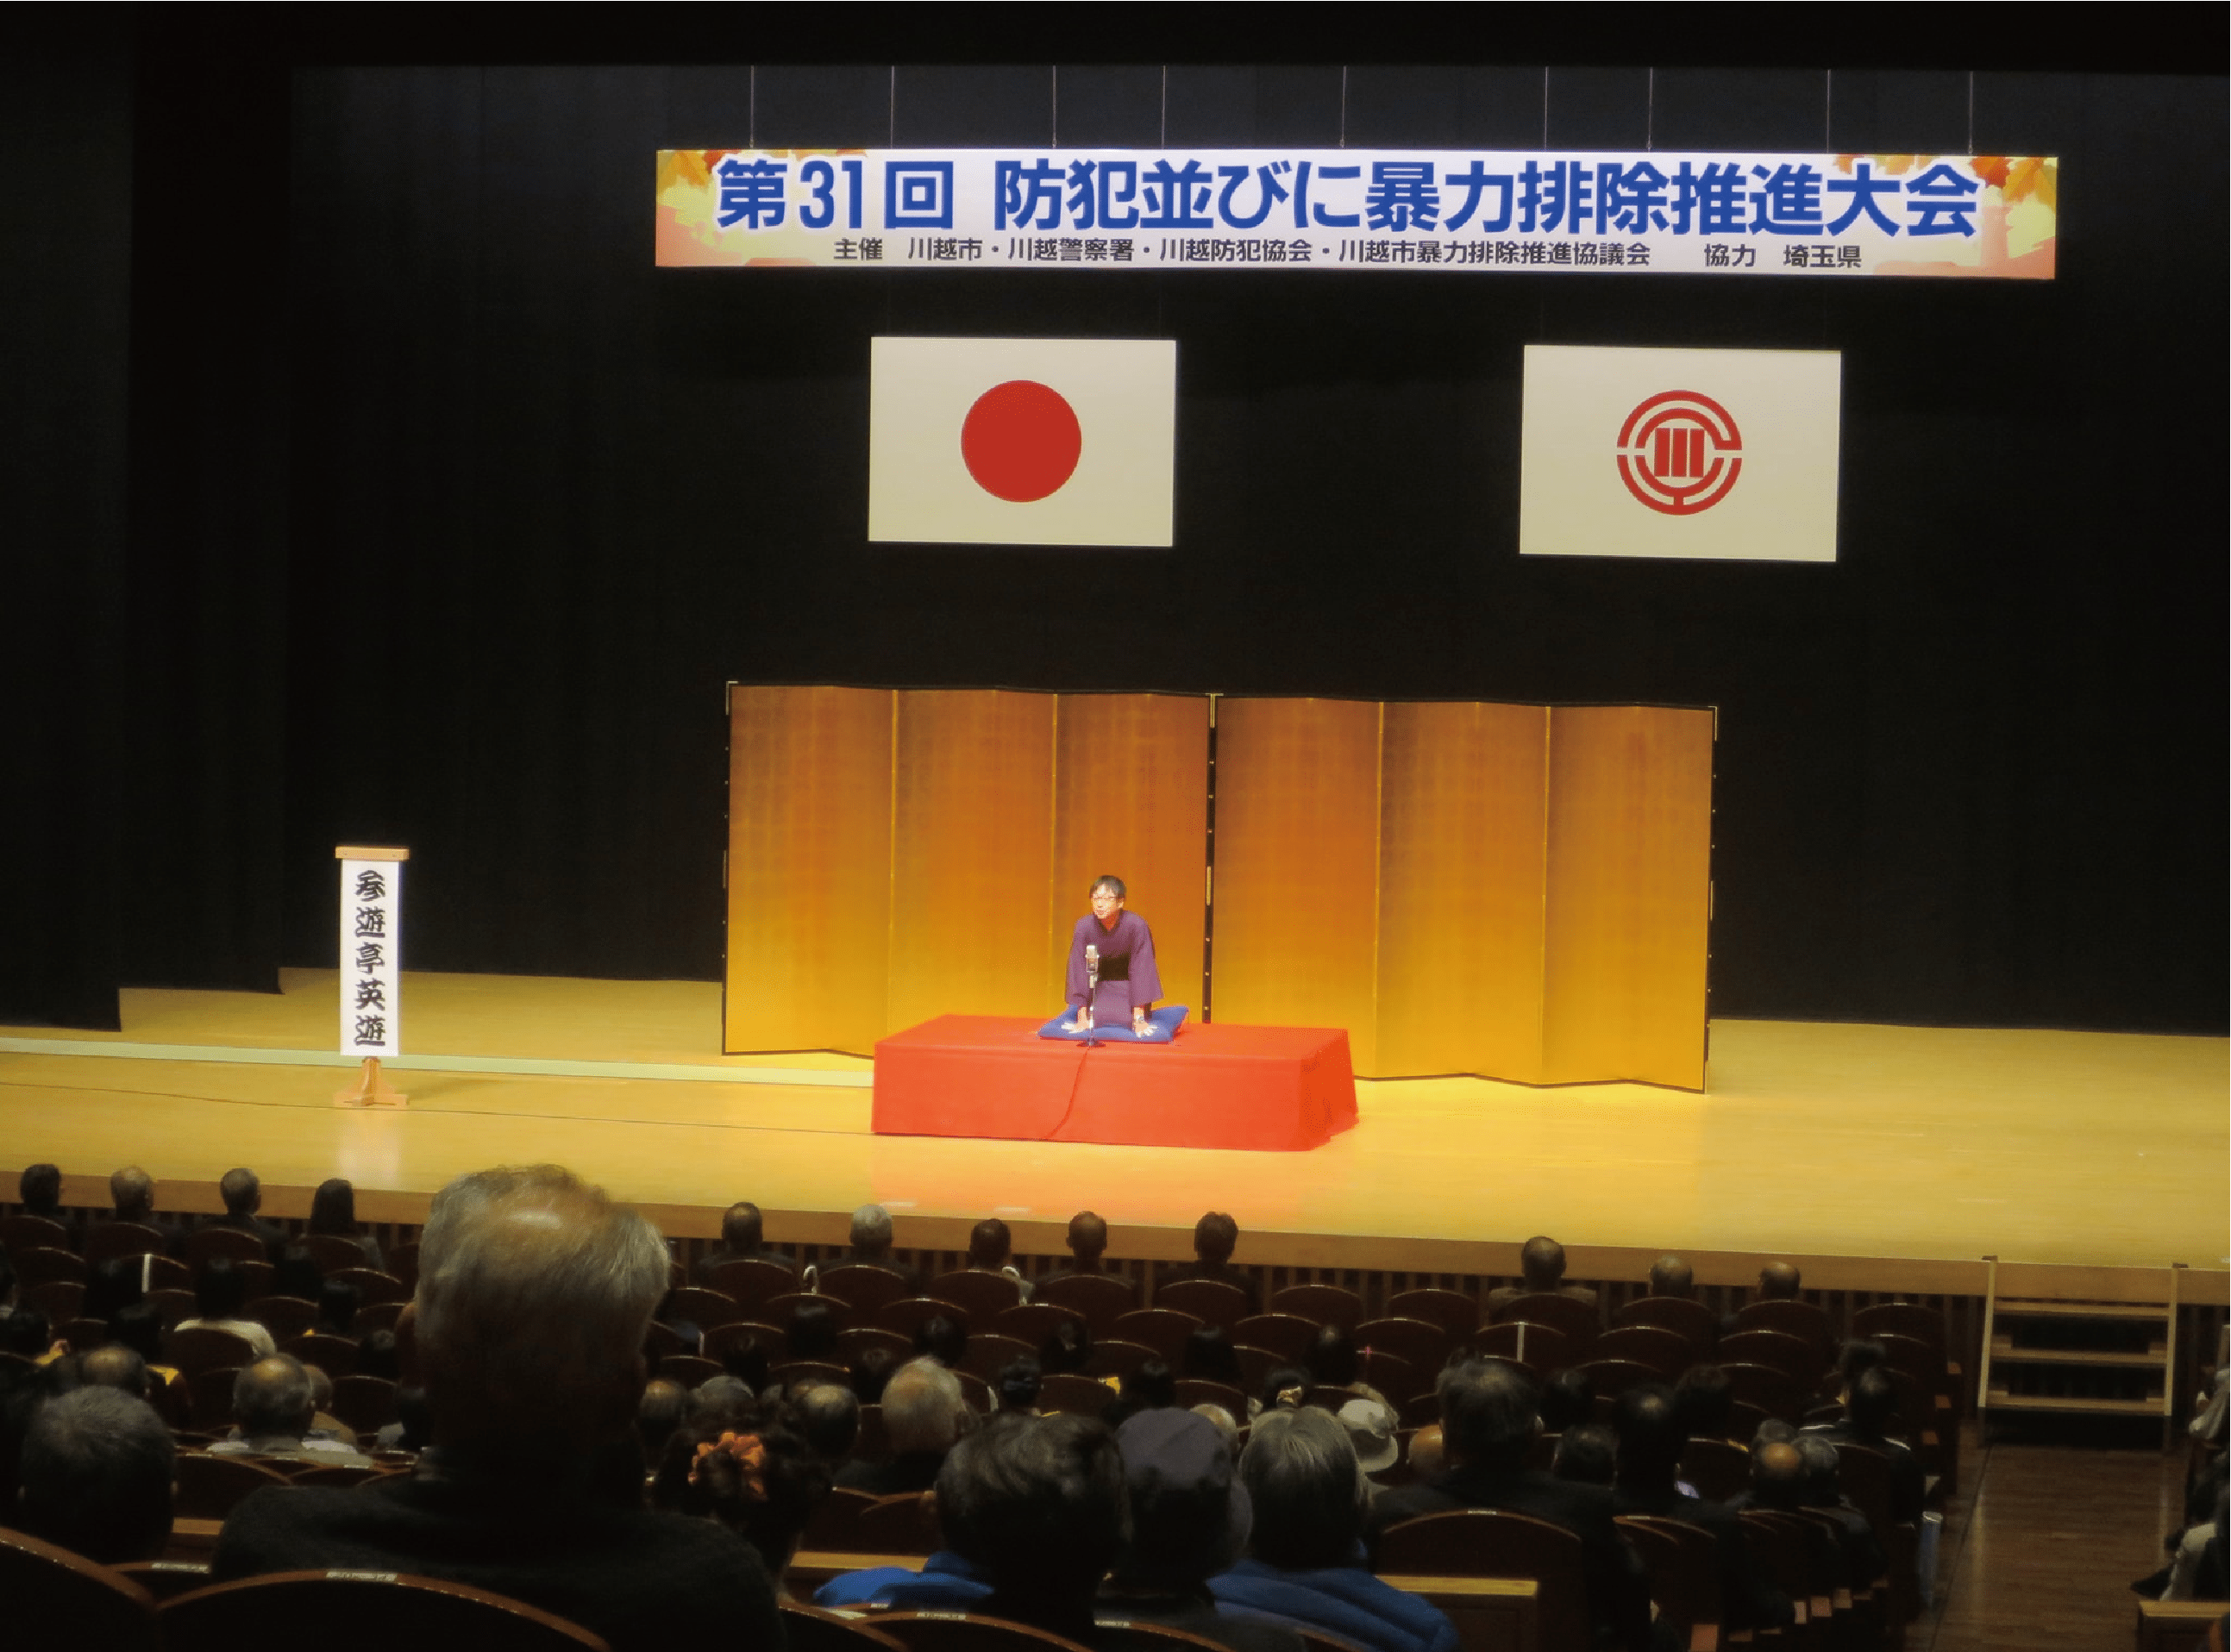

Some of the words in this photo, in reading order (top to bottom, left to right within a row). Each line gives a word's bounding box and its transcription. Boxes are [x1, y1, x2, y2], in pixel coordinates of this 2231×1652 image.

[717, 159, 954, 230] 第31回
[994, 159, 1980, 237] 防犯並びに暴力排除推進大会
[834, 237, 883, 260] 主催
[908, 237, 1651, 266] 川越市・川越警察署・川越防犯協会・川越市暴力排除推進協議会
[1704, 243, 1757, 267] 協力
[1783, 244, 1862, 268] 埼玉県
